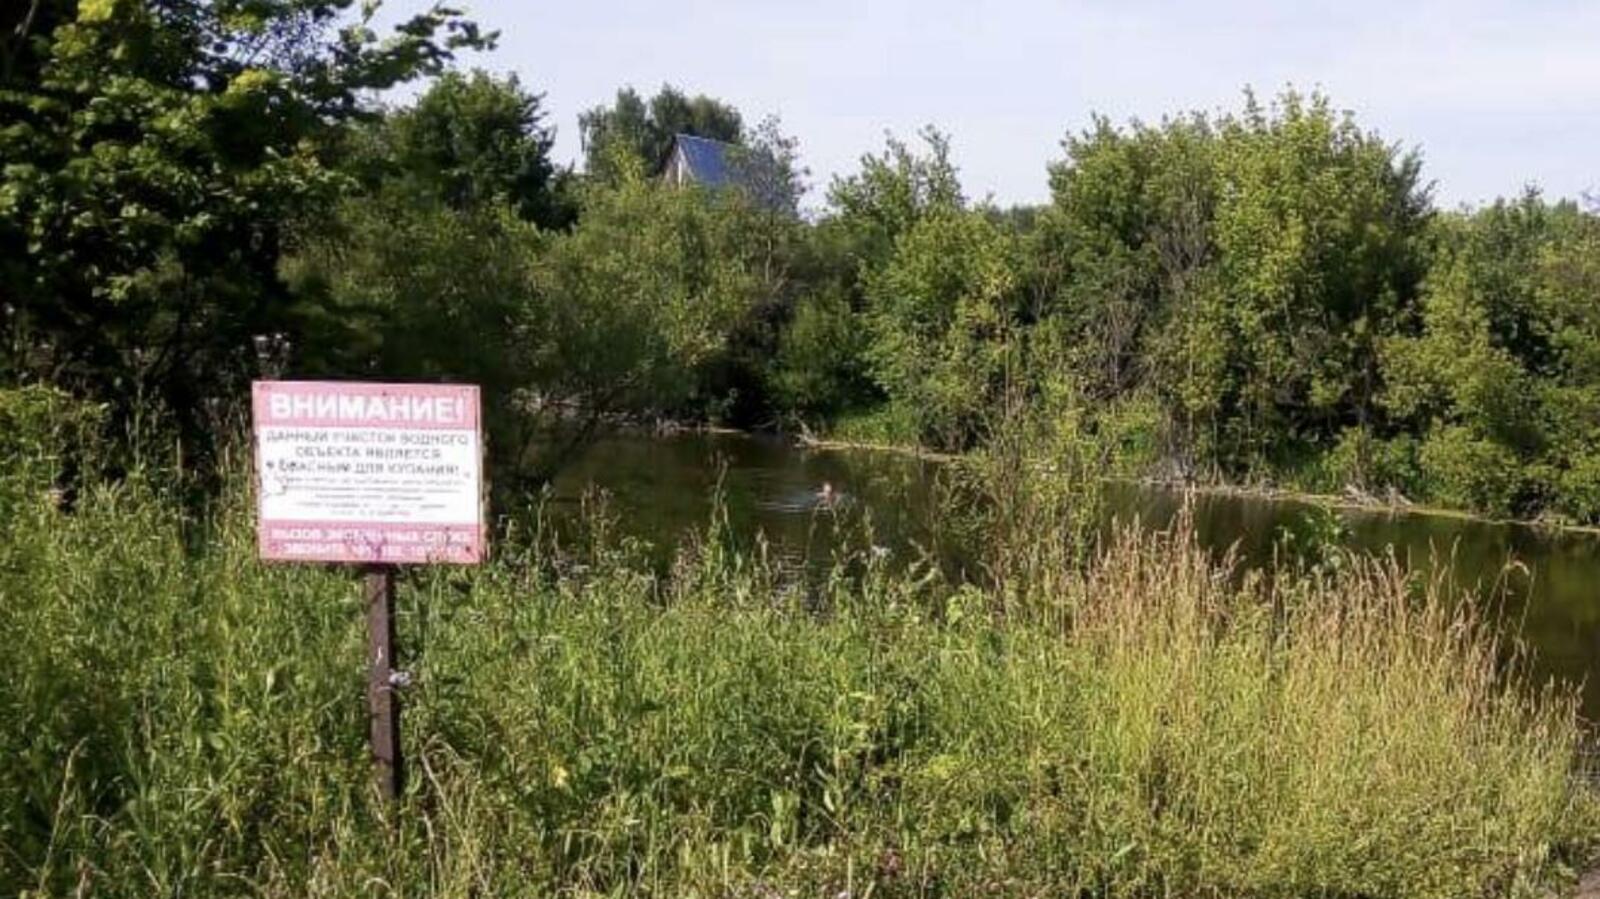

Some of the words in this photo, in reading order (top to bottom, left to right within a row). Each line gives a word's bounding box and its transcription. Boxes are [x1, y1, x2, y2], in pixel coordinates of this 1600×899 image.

[270, 393, 464, 421] ВНИМАНИЕ!
[266, 430, 328, 443] ДАННЫЙ
[400, 433, 469, 446] ВОДНОГО
[295, 446, 360, 458] ОБЪЕКТА
[354, 461, 384, 475] ДЛЯ
